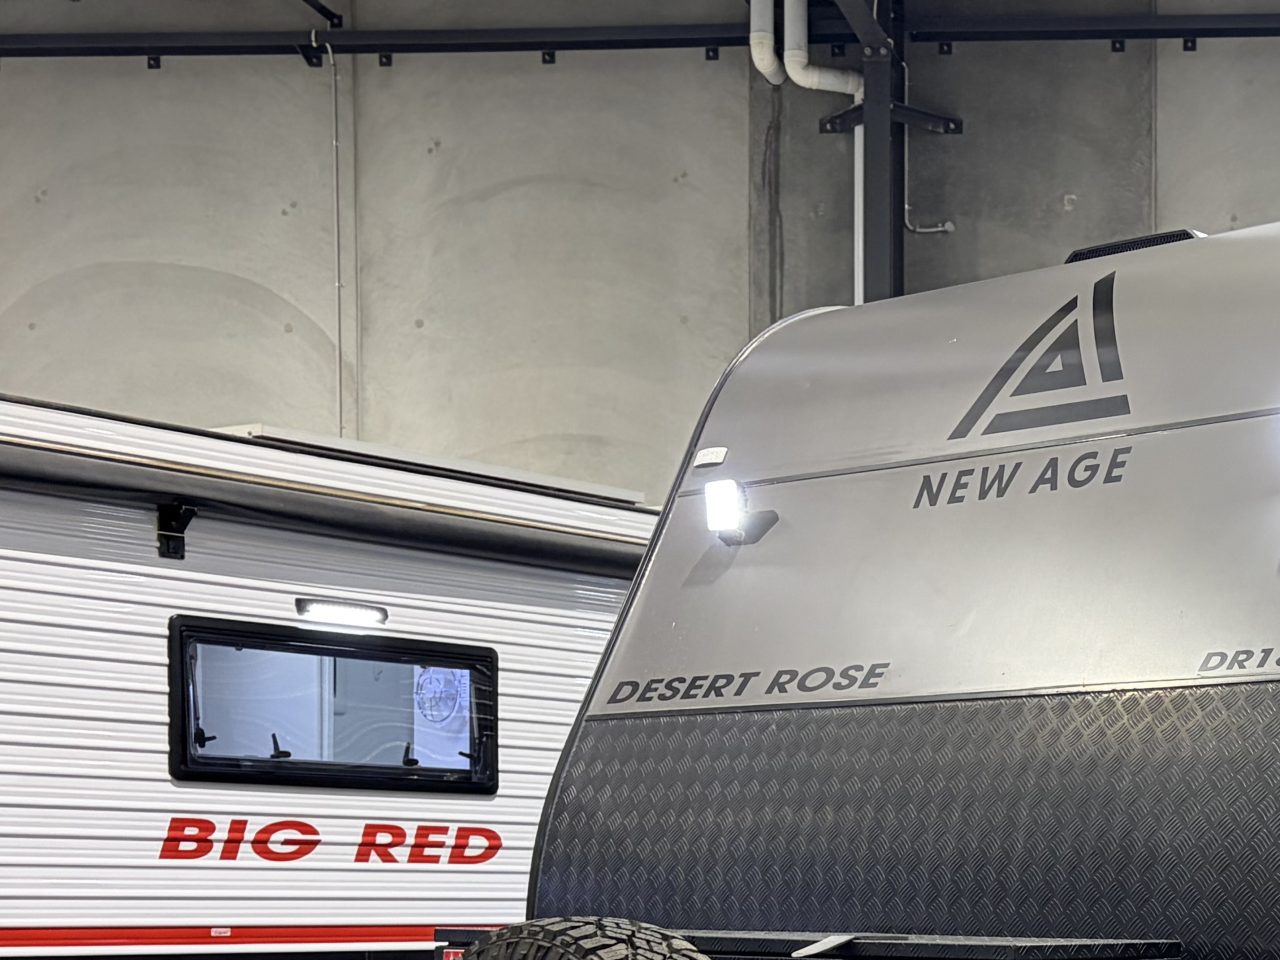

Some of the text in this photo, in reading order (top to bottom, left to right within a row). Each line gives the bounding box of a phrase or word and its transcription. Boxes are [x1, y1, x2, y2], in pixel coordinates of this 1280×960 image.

[912, 446, 1132, 508] NEW AGE
[607, 662, 890, 704] DESERT ROSE
[158, 817, 502, 864] BIG RED
